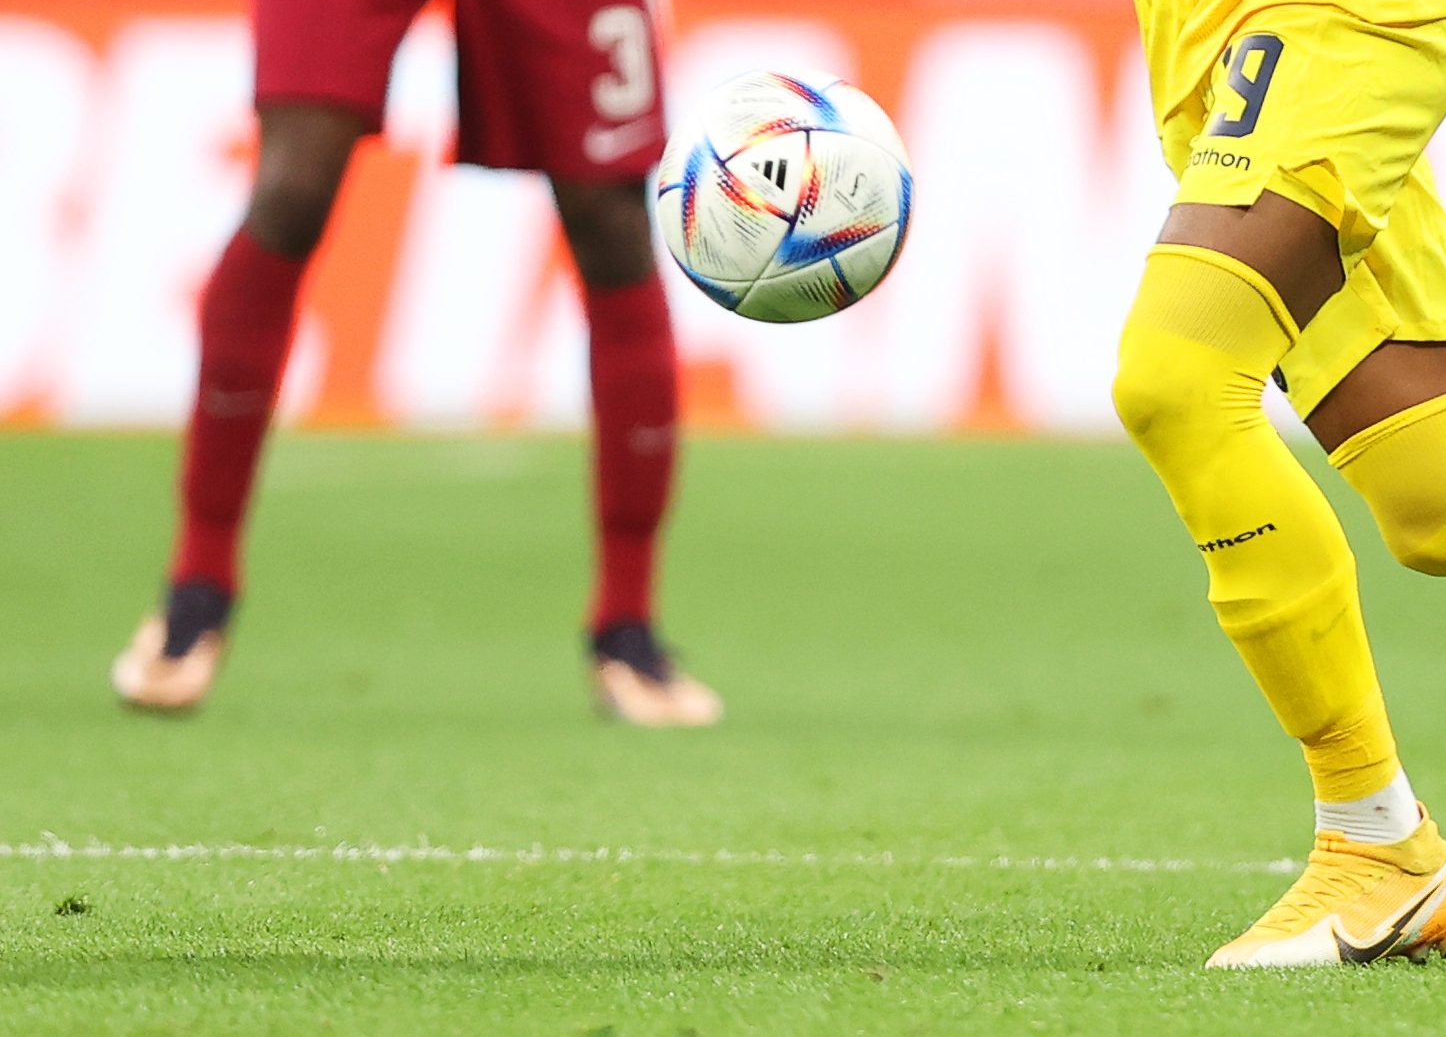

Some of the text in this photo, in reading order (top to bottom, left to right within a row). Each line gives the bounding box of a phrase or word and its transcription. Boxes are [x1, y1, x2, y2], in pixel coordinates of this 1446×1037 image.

[588, 4, 655, 122] 3
[1208, 33, 1285, 139] 9
[1198, 523, 1277, 553] athon
